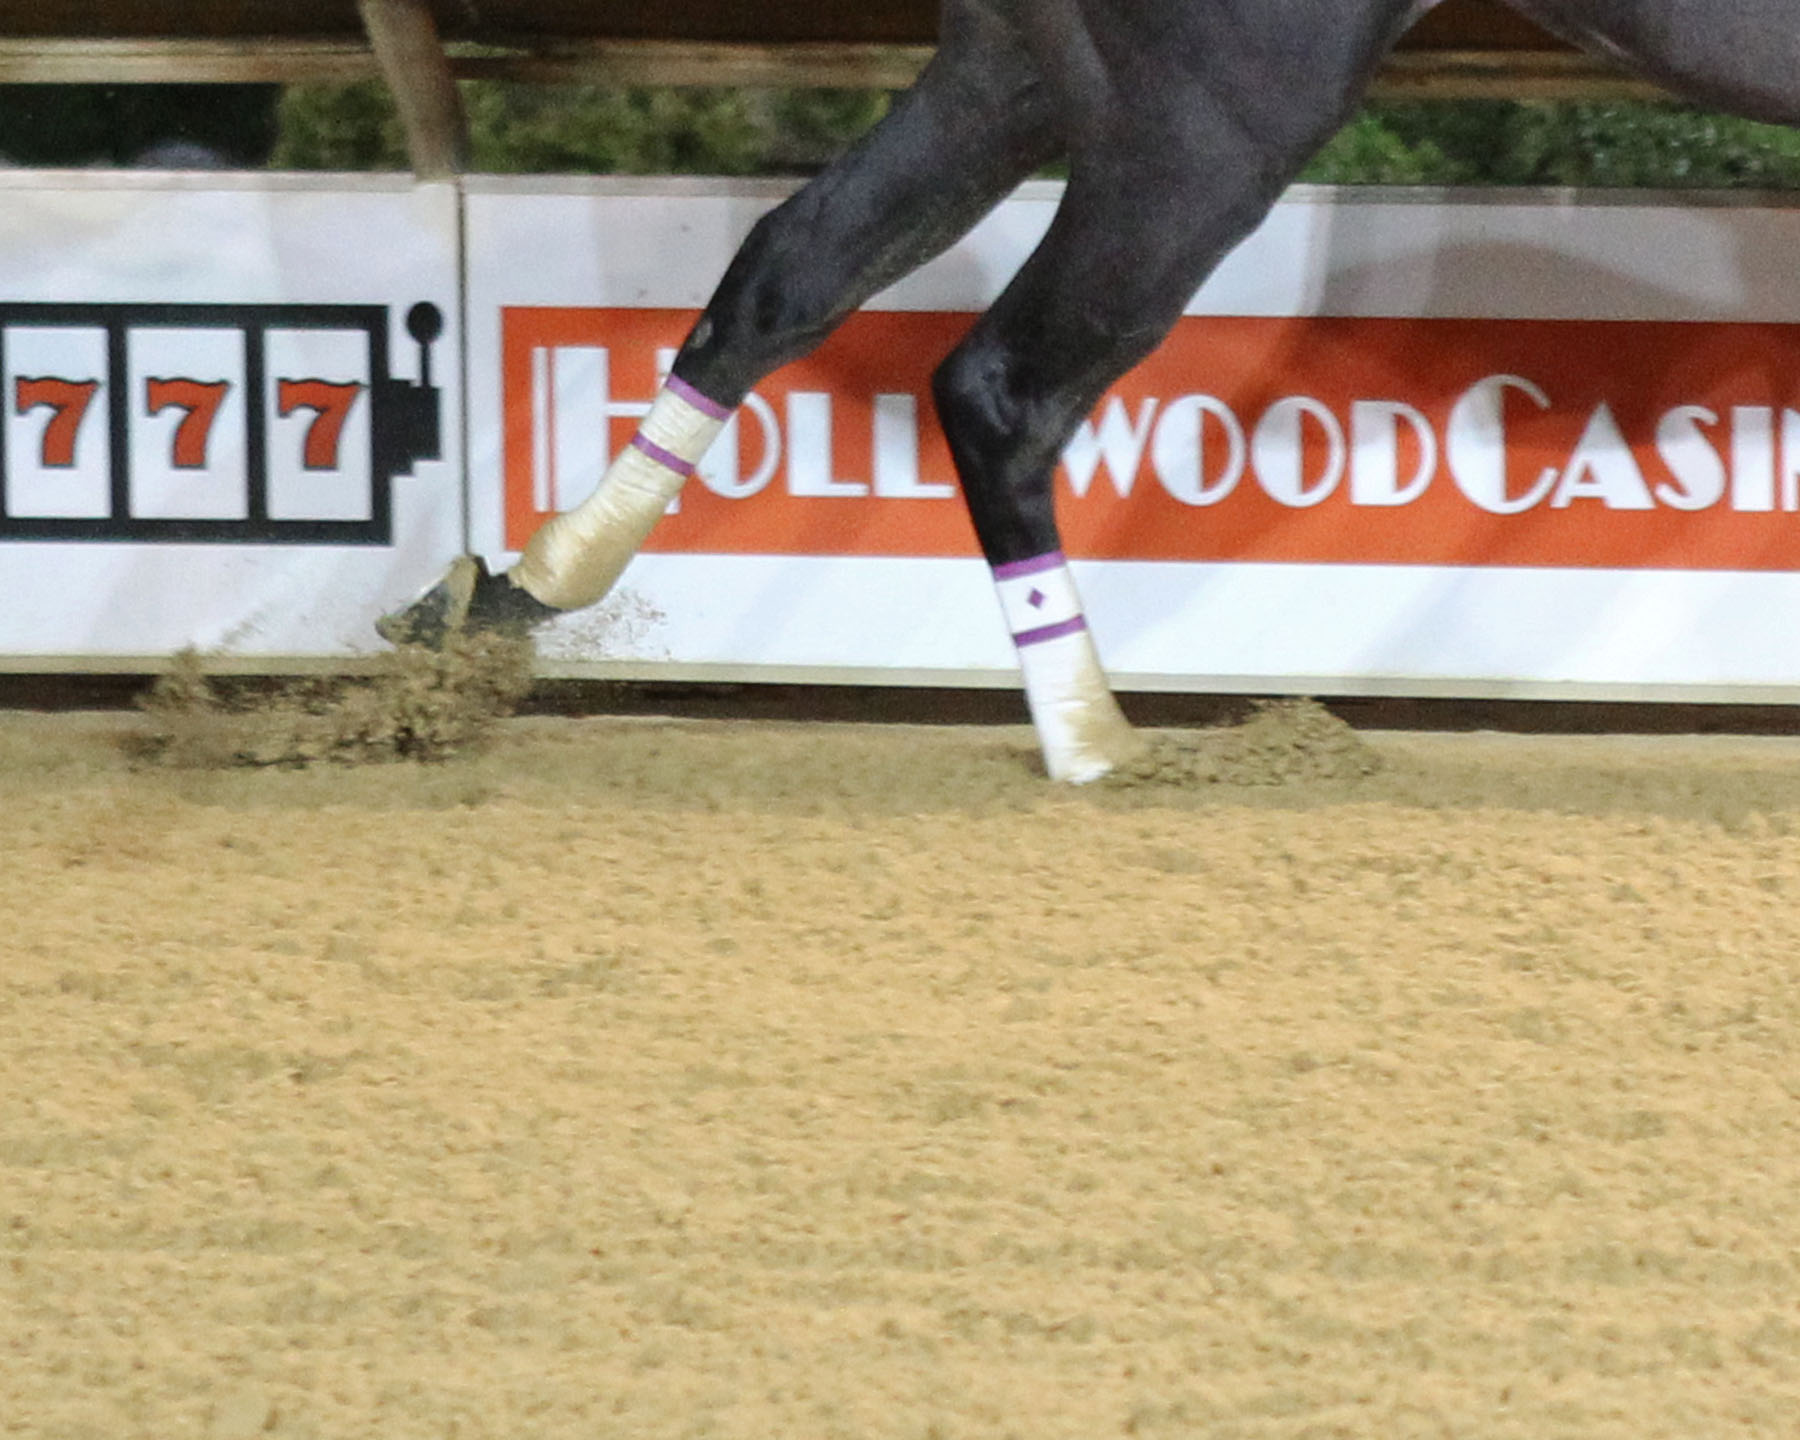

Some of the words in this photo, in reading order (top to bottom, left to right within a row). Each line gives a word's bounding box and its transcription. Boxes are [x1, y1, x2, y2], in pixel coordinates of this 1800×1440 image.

[15, 376, 101, 469] 7
[146, 377, 231, 470] 7
[278, 377, 366, 471] 7
